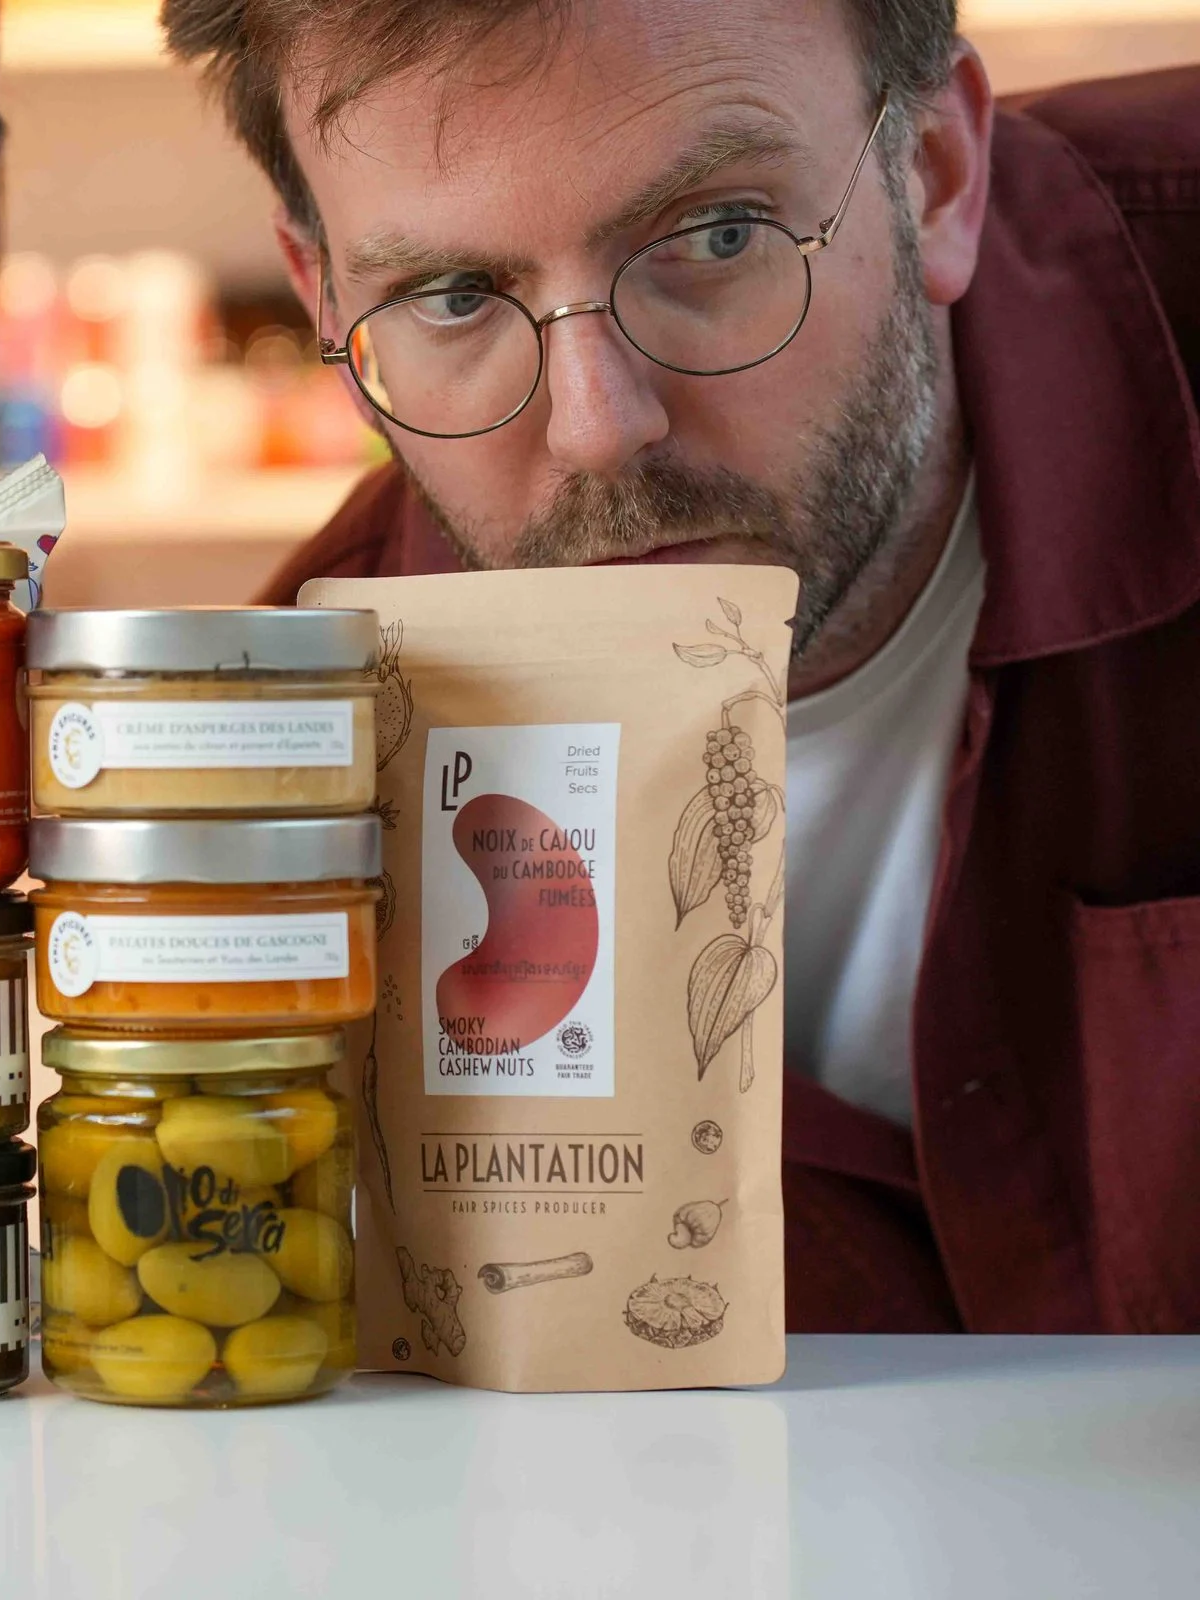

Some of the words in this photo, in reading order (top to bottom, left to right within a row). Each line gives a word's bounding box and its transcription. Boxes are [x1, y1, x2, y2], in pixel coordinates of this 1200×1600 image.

[567, 746, 600, 757] Dried
[441, 751, 472, 811] LP
[565, 766, 599, 777] Fruits
[568, 782, 598, 794] Secs
[472, 829, 516, 852] NOIX
[539, 828, 596, 851] CAJOU
[493, 865, 508, 879] DU
[512, 860, 596, 879] CAMBODGE
[539, 884, 596, 907] FUMÉES
[438, 1017, 486, 1035] SMOKY
[438, 1037, 520, 1056] CAMBODIAN
[439, 1057, 492, 1076] CASHEW
[496, 1057, 535, 1076] NUTS
[421, 1142, 448, 1183] LA
[456, 1142, 644, 1184] PLANTATION
[453, 1201, 477, 1213] FAIR
[483, 1201, 527, 1213] SPICES
[535, 1201, 606, 1214] PRODUCER
